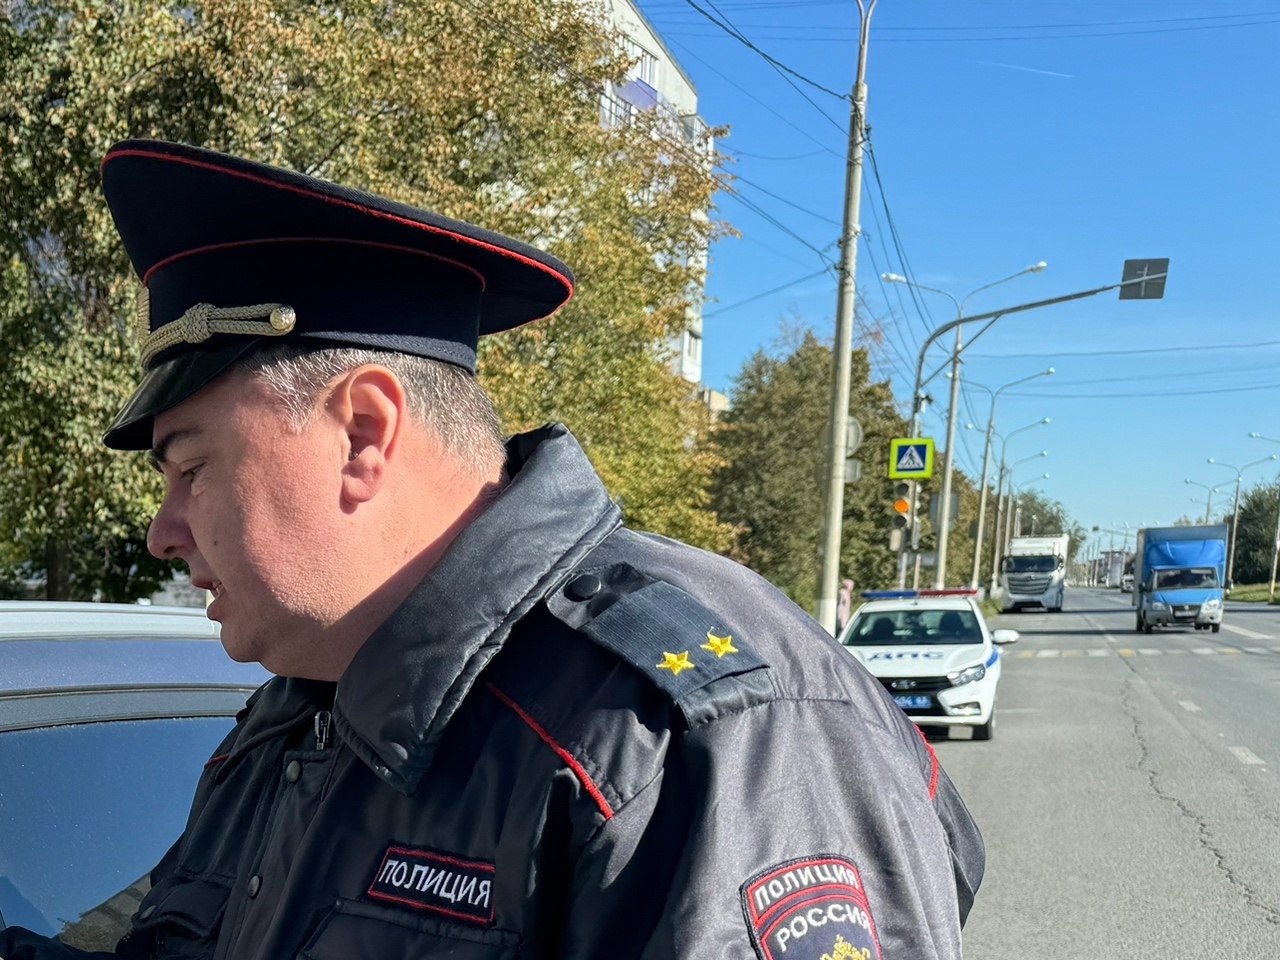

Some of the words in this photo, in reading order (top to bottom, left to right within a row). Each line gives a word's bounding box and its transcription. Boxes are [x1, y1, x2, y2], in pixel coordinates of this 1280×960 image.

[379, 859, 491, 908] ПОЛИЦИЯ
[754, 864, 860, 911] ПОЛИЦИЯ
[775, 904, 871, 952] РОССИЯ
